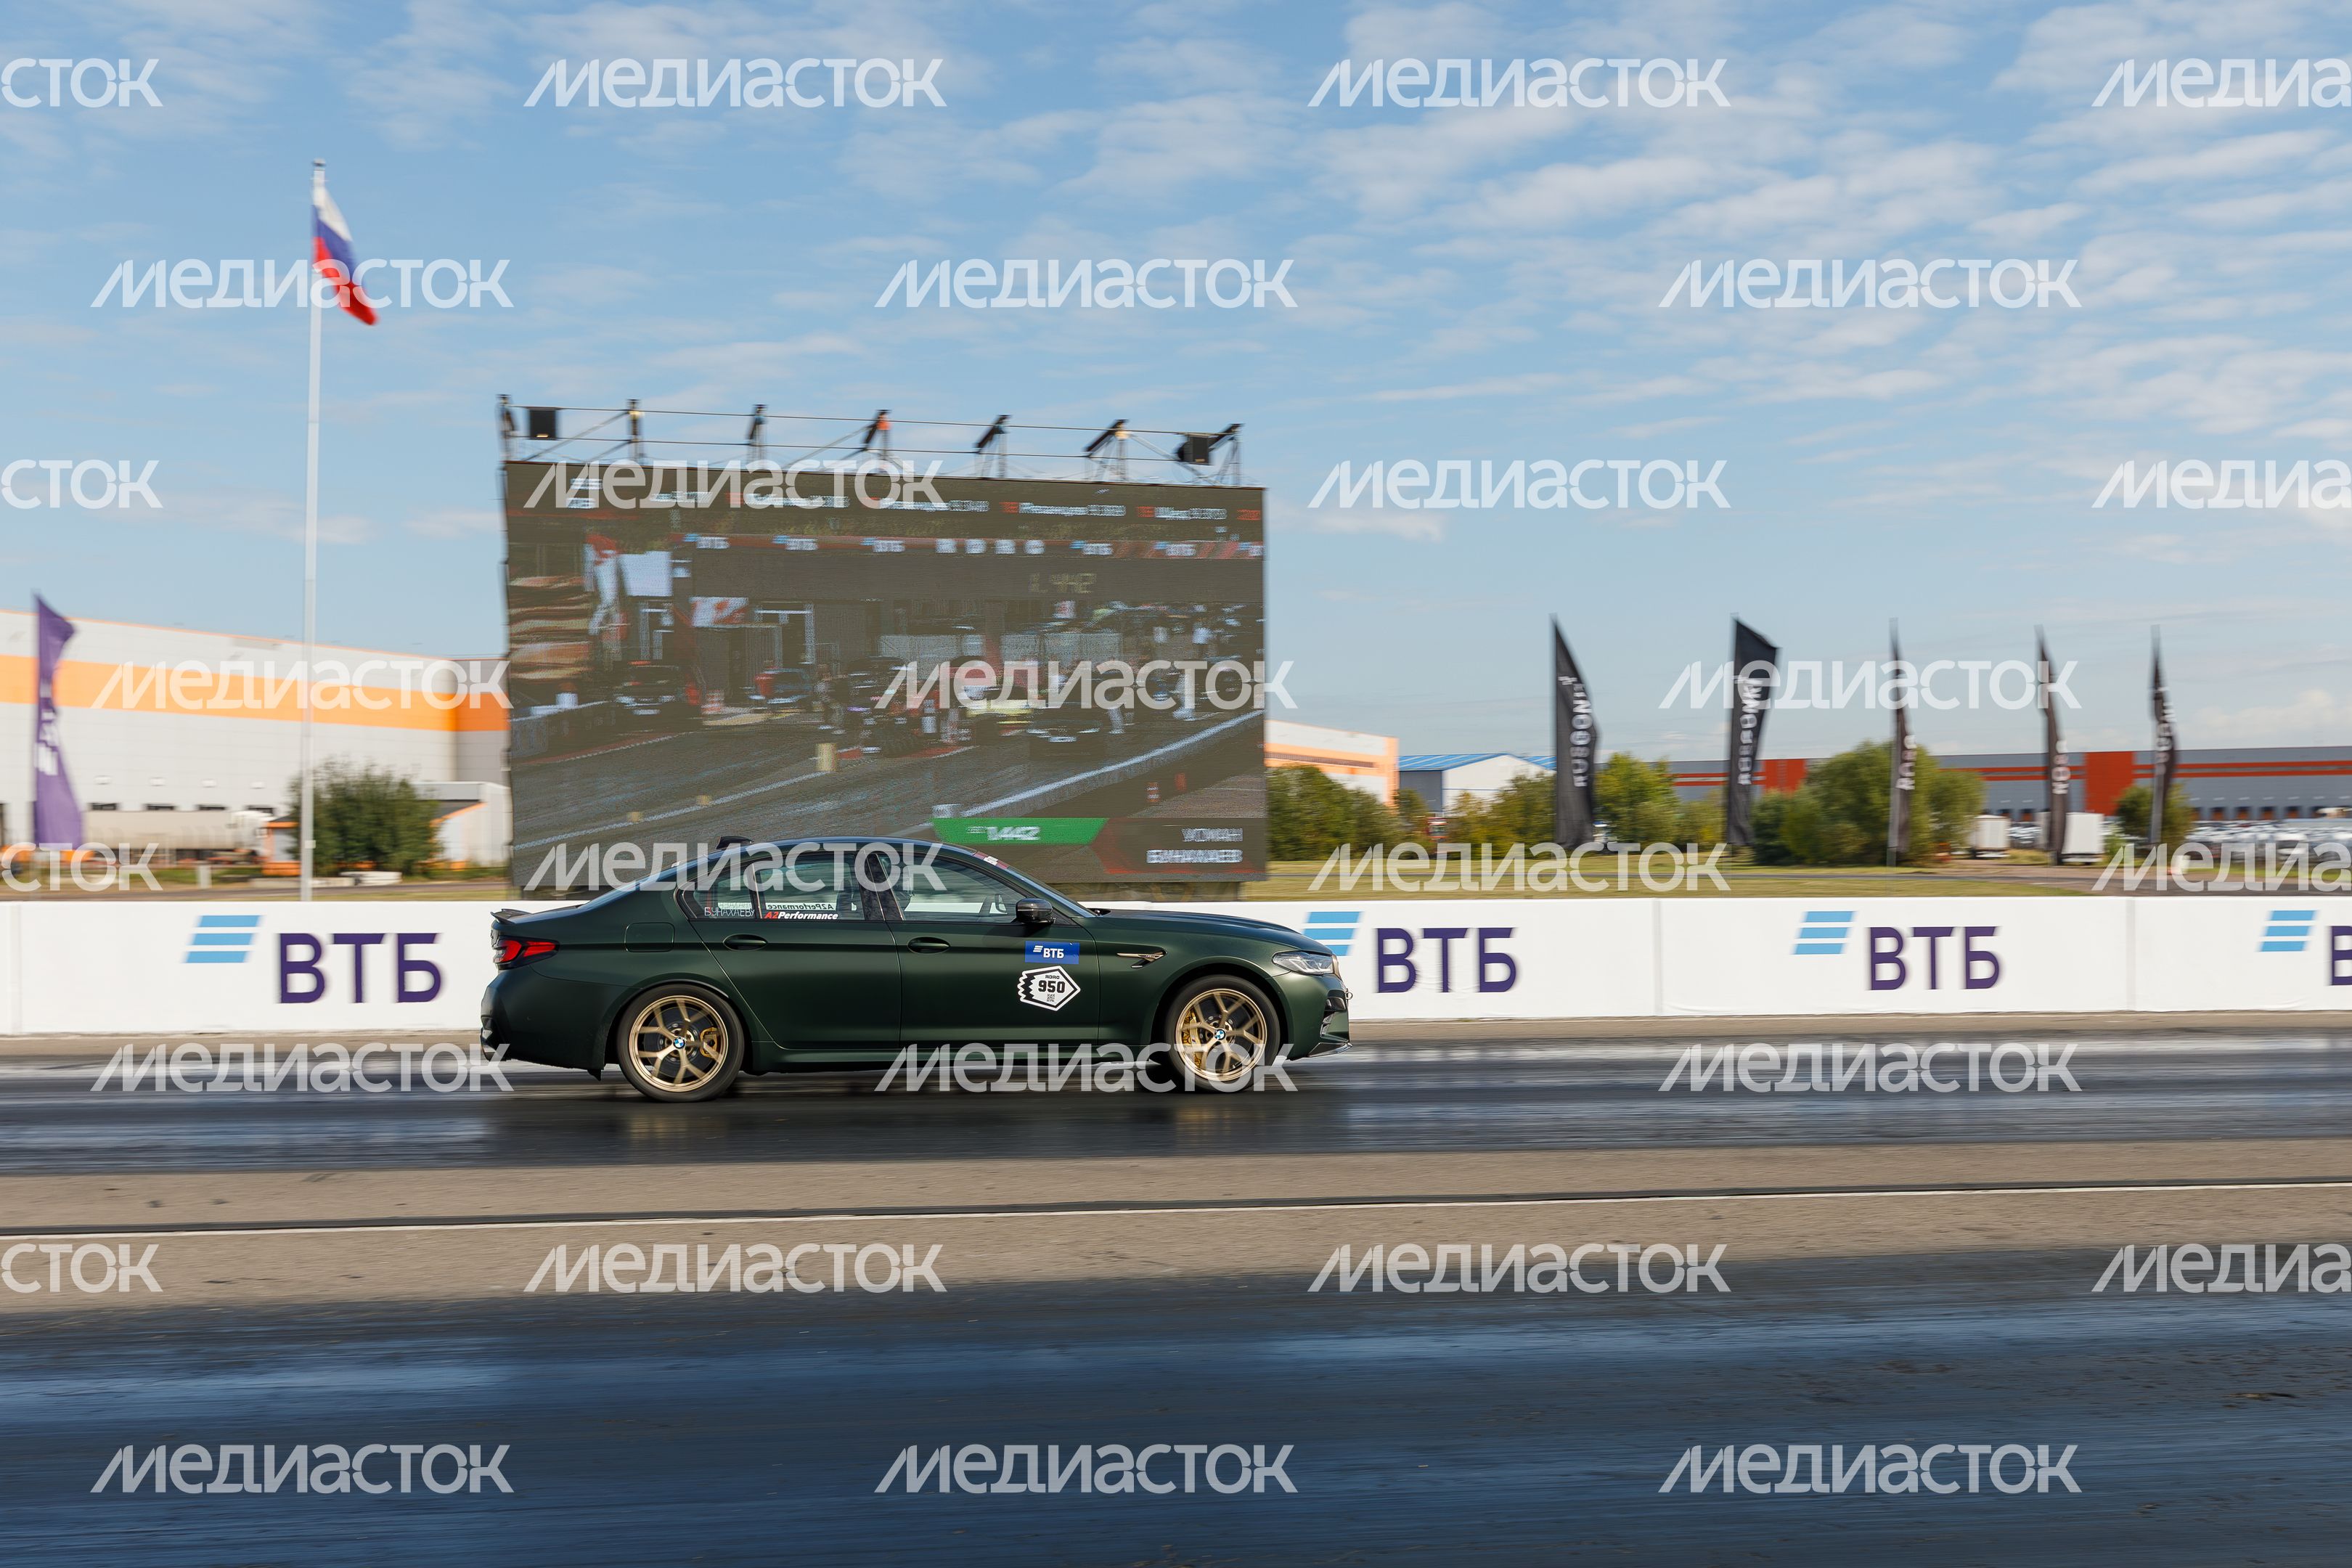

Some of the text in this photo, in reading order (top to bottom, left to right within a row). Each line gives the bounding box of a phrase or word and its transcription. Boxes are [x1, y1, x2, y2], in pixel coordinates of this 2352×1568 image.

[279, 933, 442, 1003] ВТБ
[1043, 948, 1064, 959] ВТБ
[1376, 927, 1518, 992] ВТБ
[1869, 926, 2001, 990] ВТБ
[1038, 980, 1066, 993] 950
